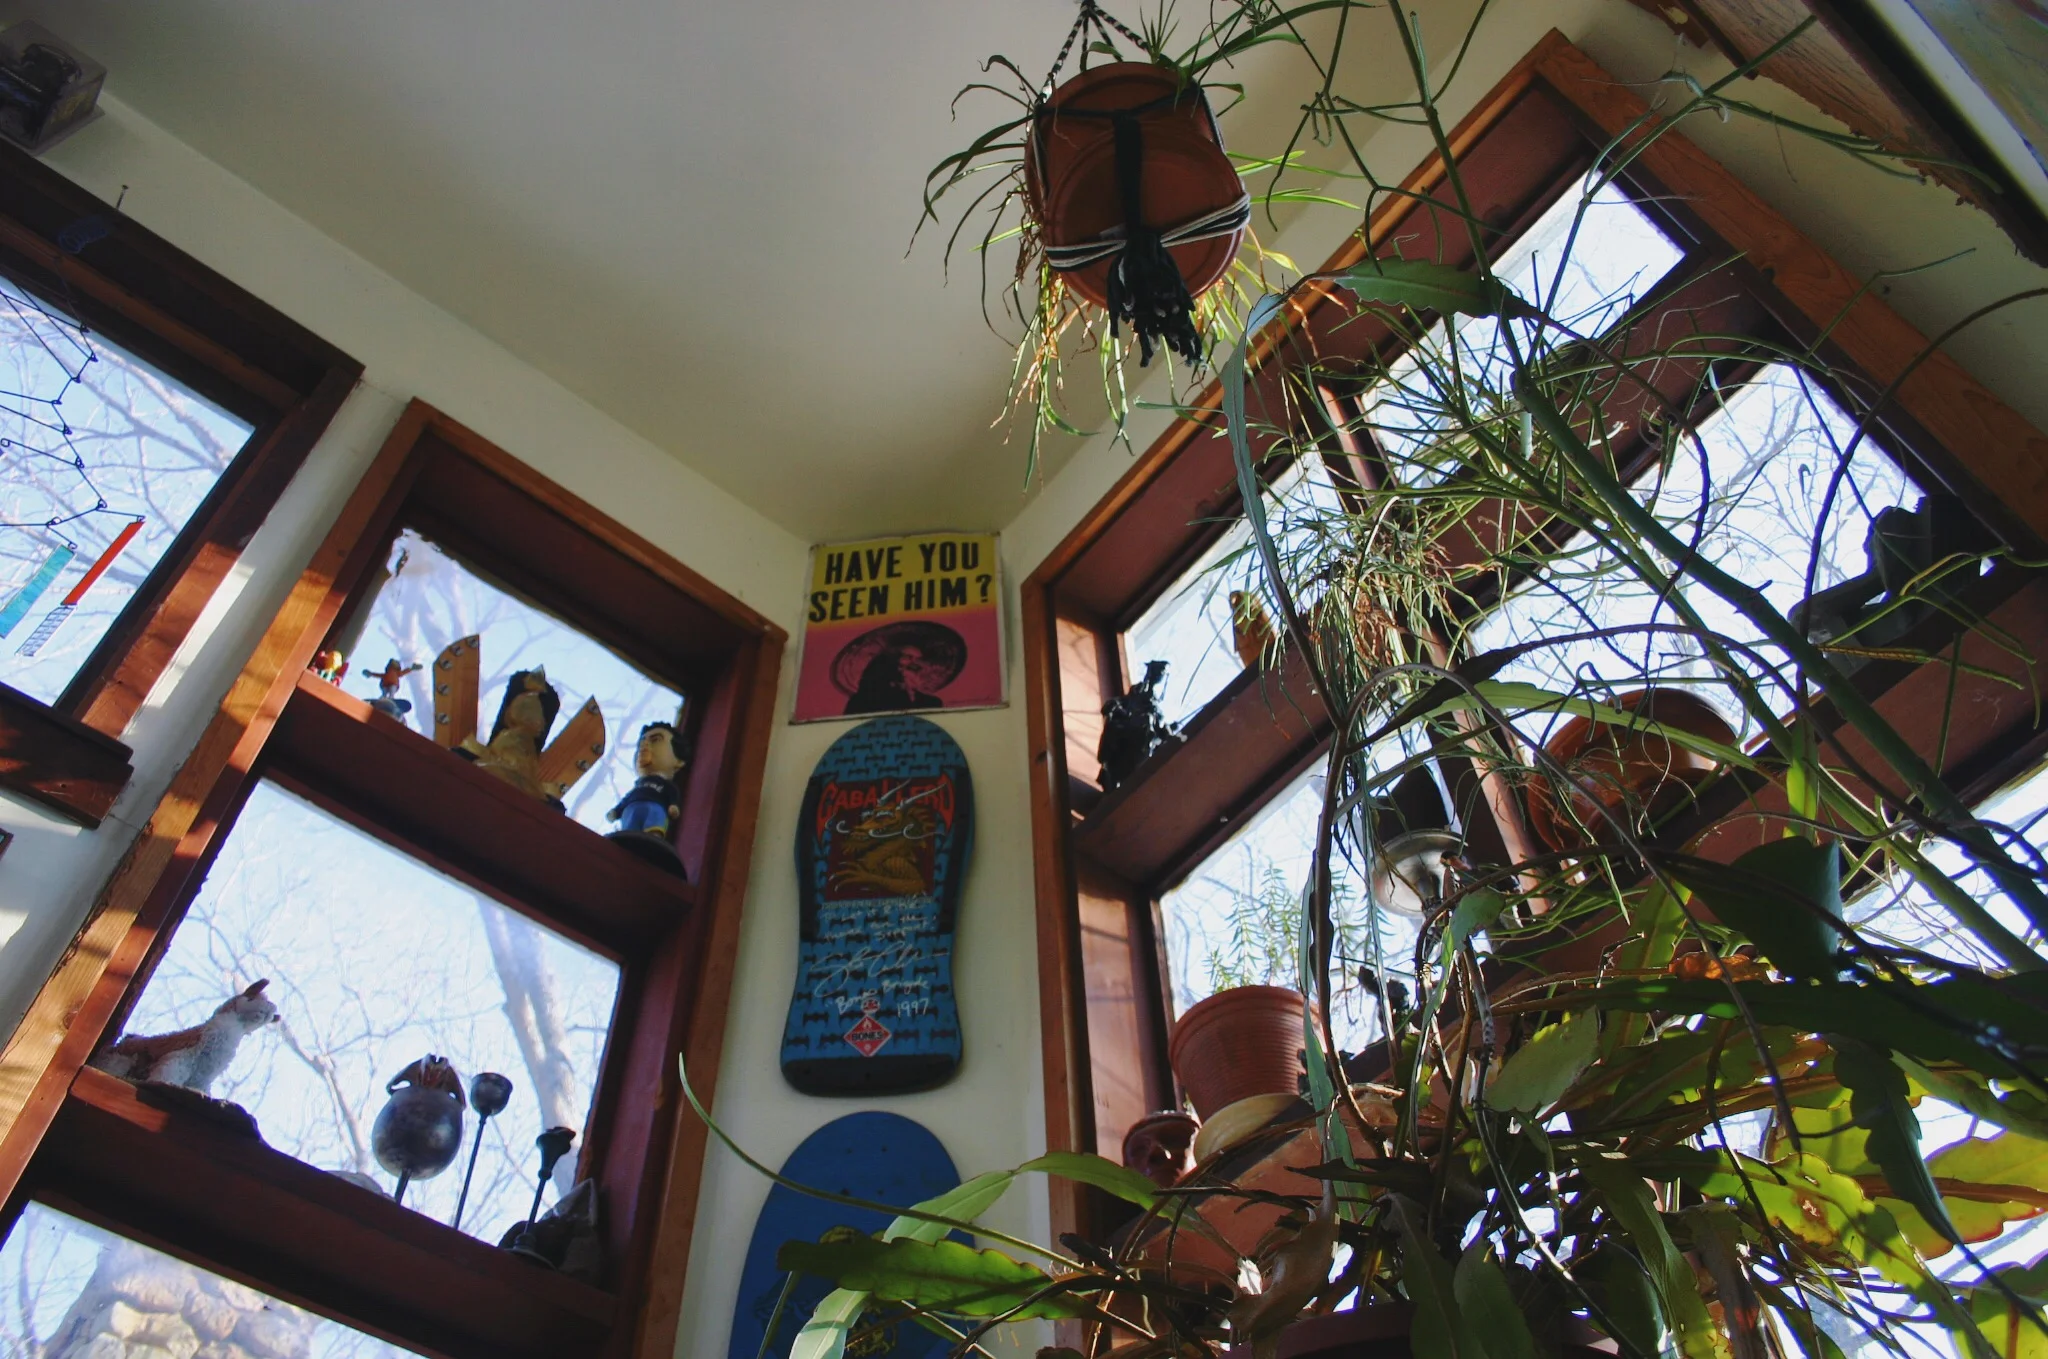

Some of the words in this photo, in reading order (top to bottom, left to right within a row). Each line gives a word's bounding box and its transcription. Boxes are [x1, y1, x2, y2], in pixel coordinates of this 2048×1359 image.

[825, 546, 903, 584] HAVE
[919, 541, 979, 572] YOU
[809, 584, 888, 622] SEEN
[816, 774, 954, 846] CABALLERO
[896, 997, 929, 1018] 1997
[851, 1031, 884, 1042] BONES
